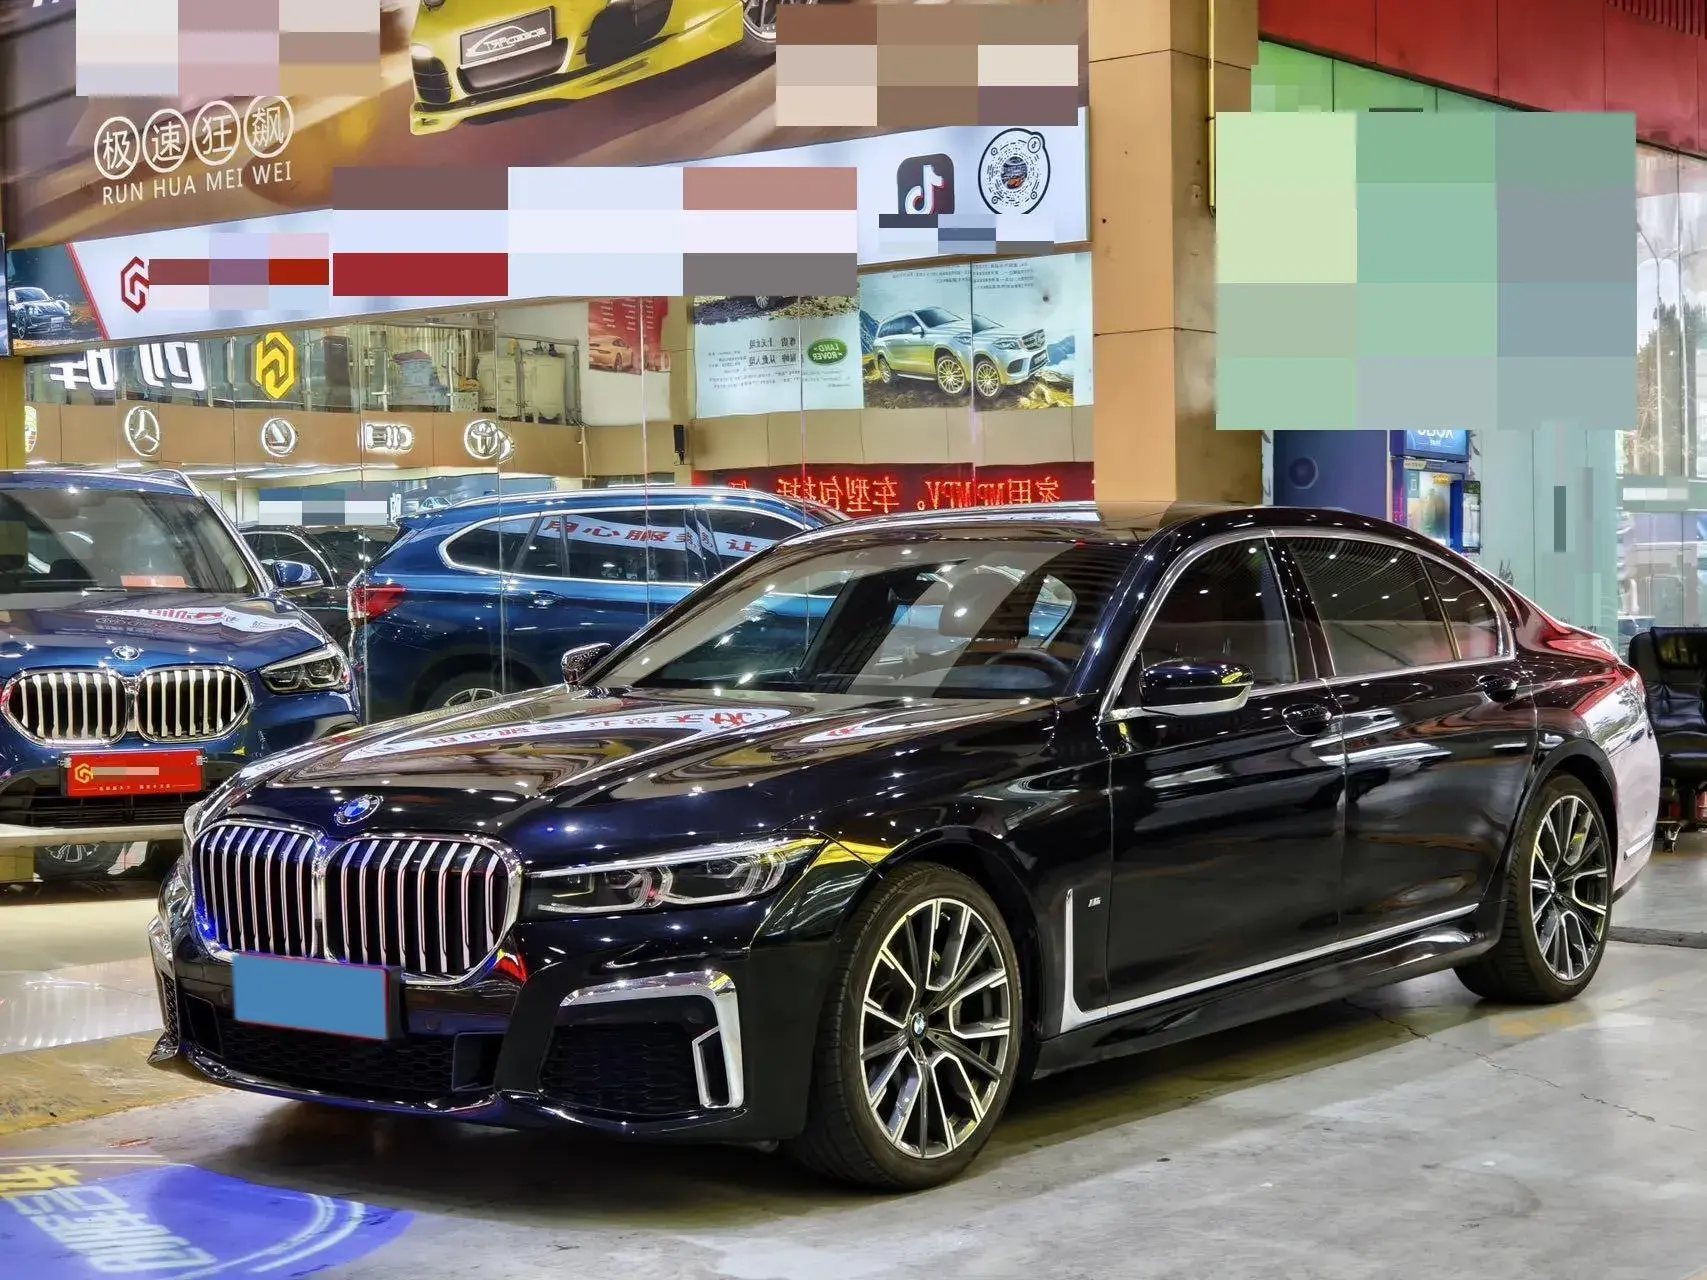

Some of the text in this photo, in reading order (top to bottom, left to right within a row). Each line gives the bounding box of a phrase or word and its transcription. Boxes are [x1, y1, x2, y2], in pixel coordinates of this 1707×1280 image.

[101, 105, 285, 171] 极速狂飙
[102, 160, 293, 206] RUN HUA MEI WEI
